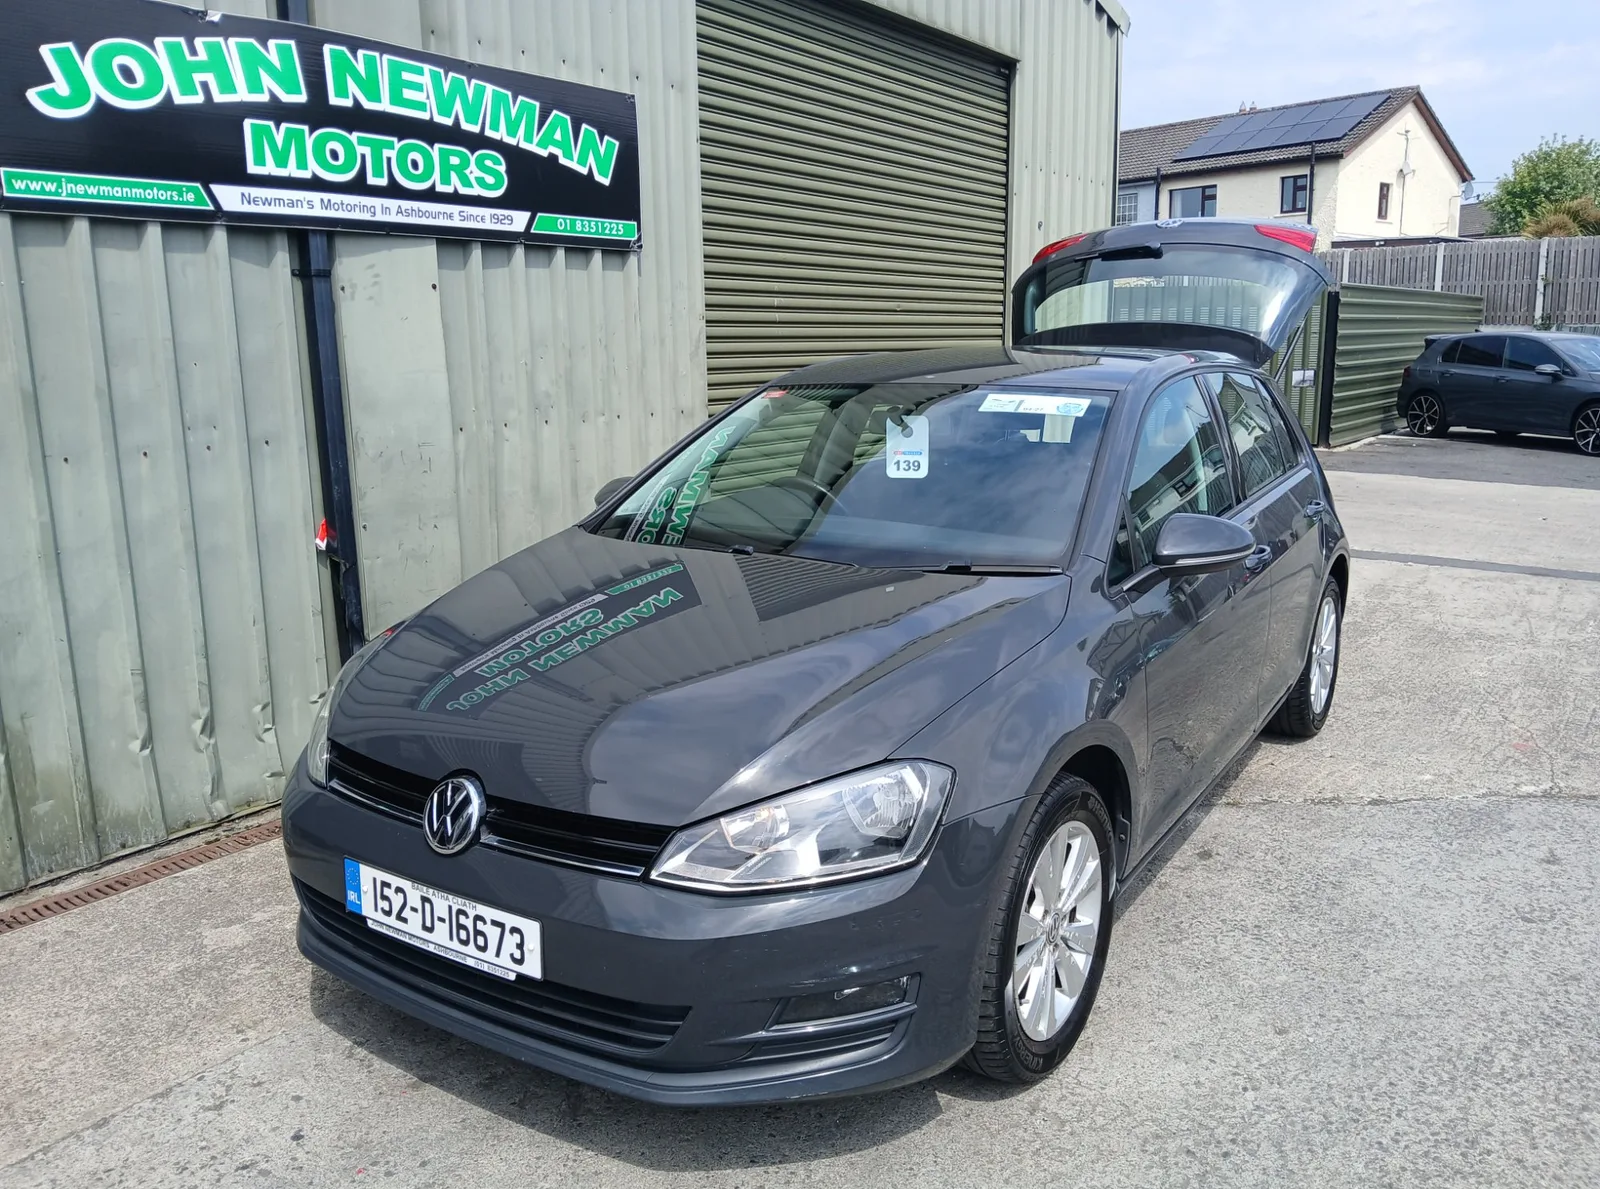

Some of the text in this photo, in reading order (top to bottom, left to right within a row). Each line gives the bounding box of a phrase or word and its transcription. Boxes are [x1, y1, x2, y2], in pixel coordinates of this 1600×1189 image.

[26, 37, 620, 186] JOHN NEWMAN
[243, 118, 508, 198] MOTORS
[11, 177, 195, 203] www.jnewmanmotors.ie
[240, 191, 514, 226] Newman's Motoring In Ashbourne Since 1929
[557, 218, 624, 235] 01 8351225
[893, 459, 921, 472] 139
[347, 889, 361, 905] IRL
[451, 896, 477, 911] CLIATH
[373, 876, 526, 966] 152-D-16673
